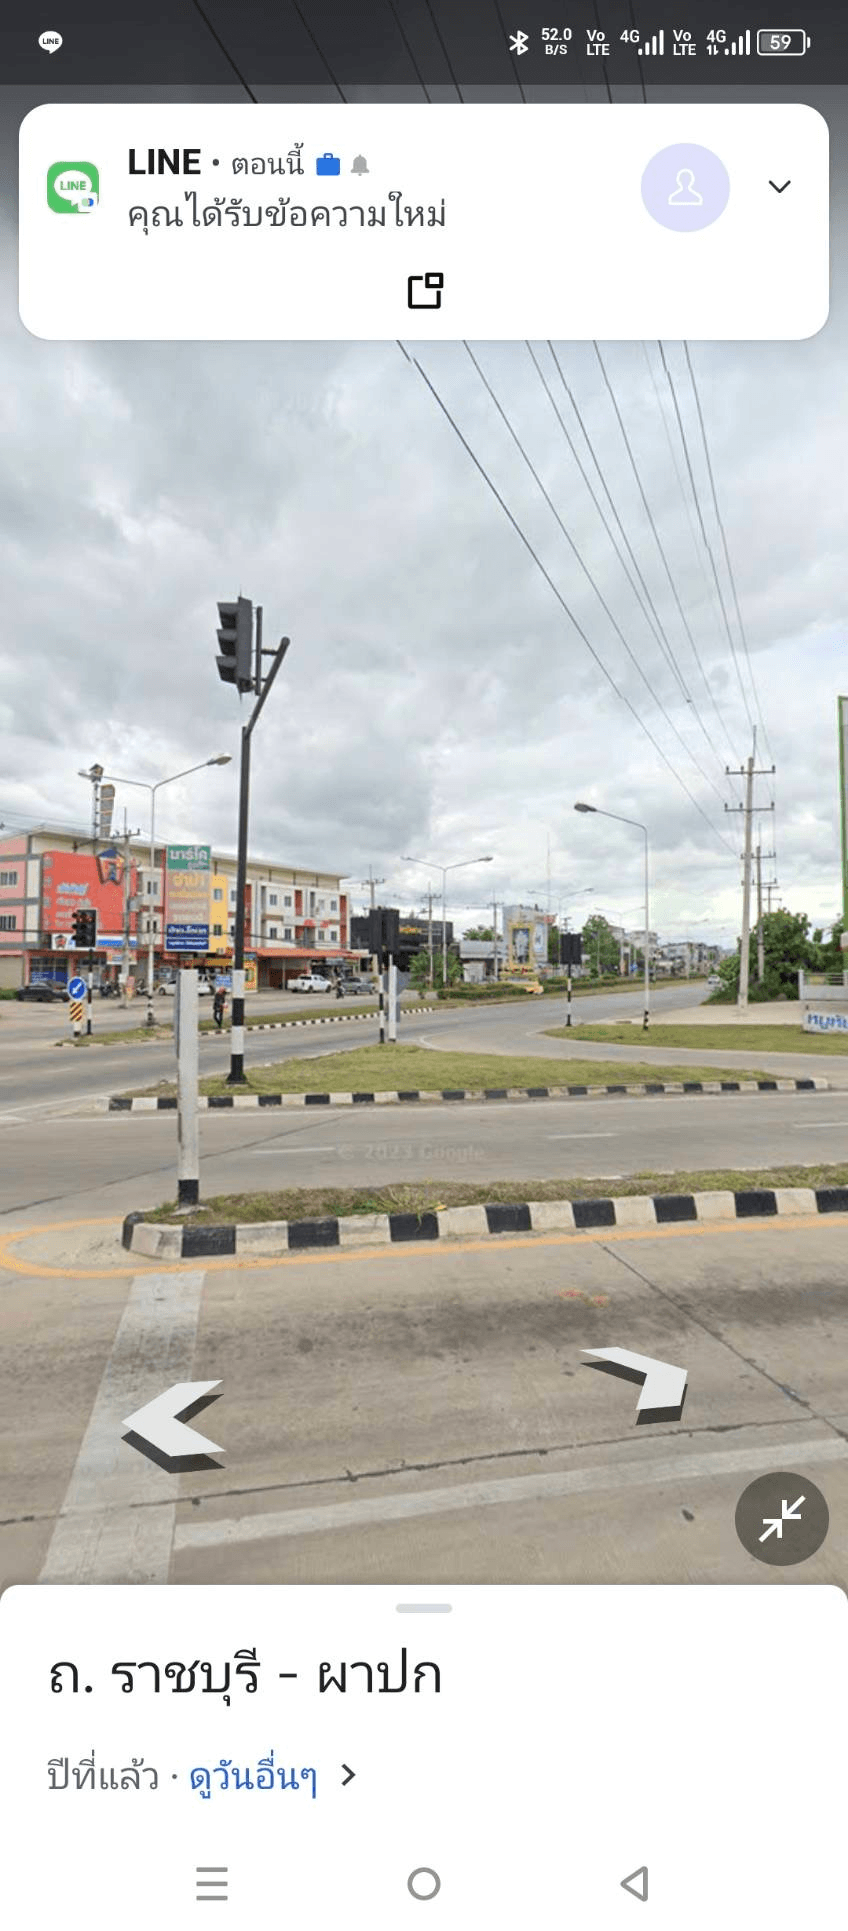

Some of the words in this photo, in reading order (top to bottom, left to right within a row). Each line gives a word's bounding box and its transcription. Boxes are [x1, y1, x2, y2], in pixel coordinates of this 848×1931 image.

[42, 37, 59, 45] LINE
[541, 27, 573, 41] 52.0
[585, 29, 606, 42] Vo
[619, 29, 640, 44] 4G
[672, 29, 692, 42] Vo
[706, 29, 727, 44] 4G
[770, 34, 792, 50] 59
[545, 43, 568, 56] B/S
[586, 43, 611, 56] LTE
[672, 43, 697, 56] LTE
[128, 148, 202, 175] LINE
[231, 142, 305, 176] ตอนนี้
[60, 180, 87, 191] LINE
[128, 190, 446, 236] คุณได้รับข้อความใหม่
[49, 1661, 93, 1694] ถ.
[111, 1646, 261, 1707] ราชบุรี
[318, 1646, 441, 1694] ผาปก
[47, 1748, 159, 1790] ปีที่แล้ว
[190, 1748, 317, 1800] ดูวันอื่นๆ
